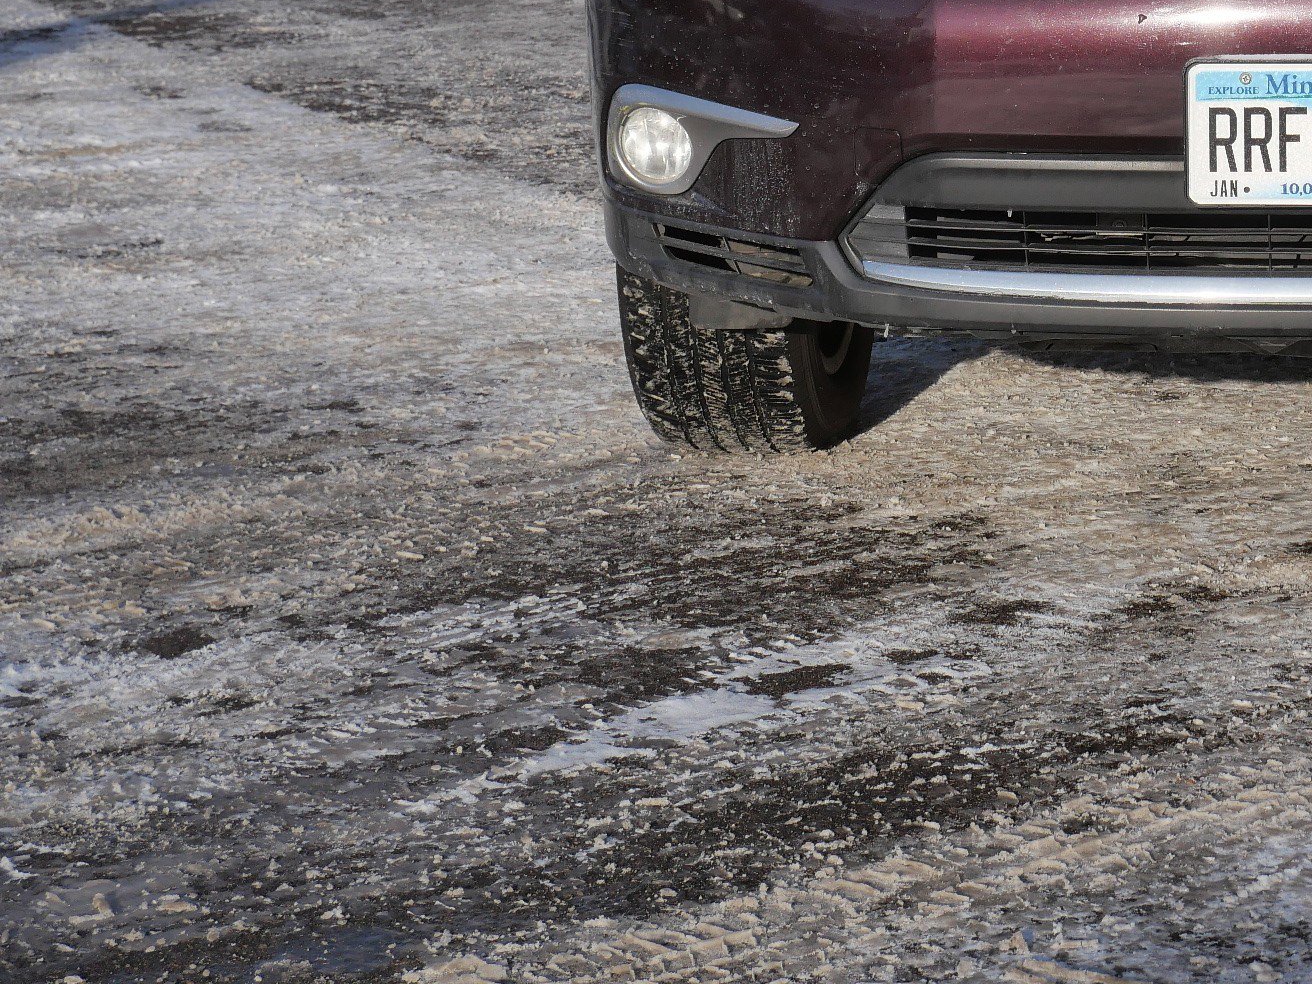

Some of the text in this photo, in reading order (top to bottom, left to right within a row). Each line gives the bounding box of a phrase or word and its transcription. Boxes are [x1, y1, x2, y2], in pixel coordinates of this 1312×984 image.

[1208, 86, 1260, 95] EXPLORE
[1208, 106, 1308, 173] RRF
[1210, 179, 1238, 198] JAN
